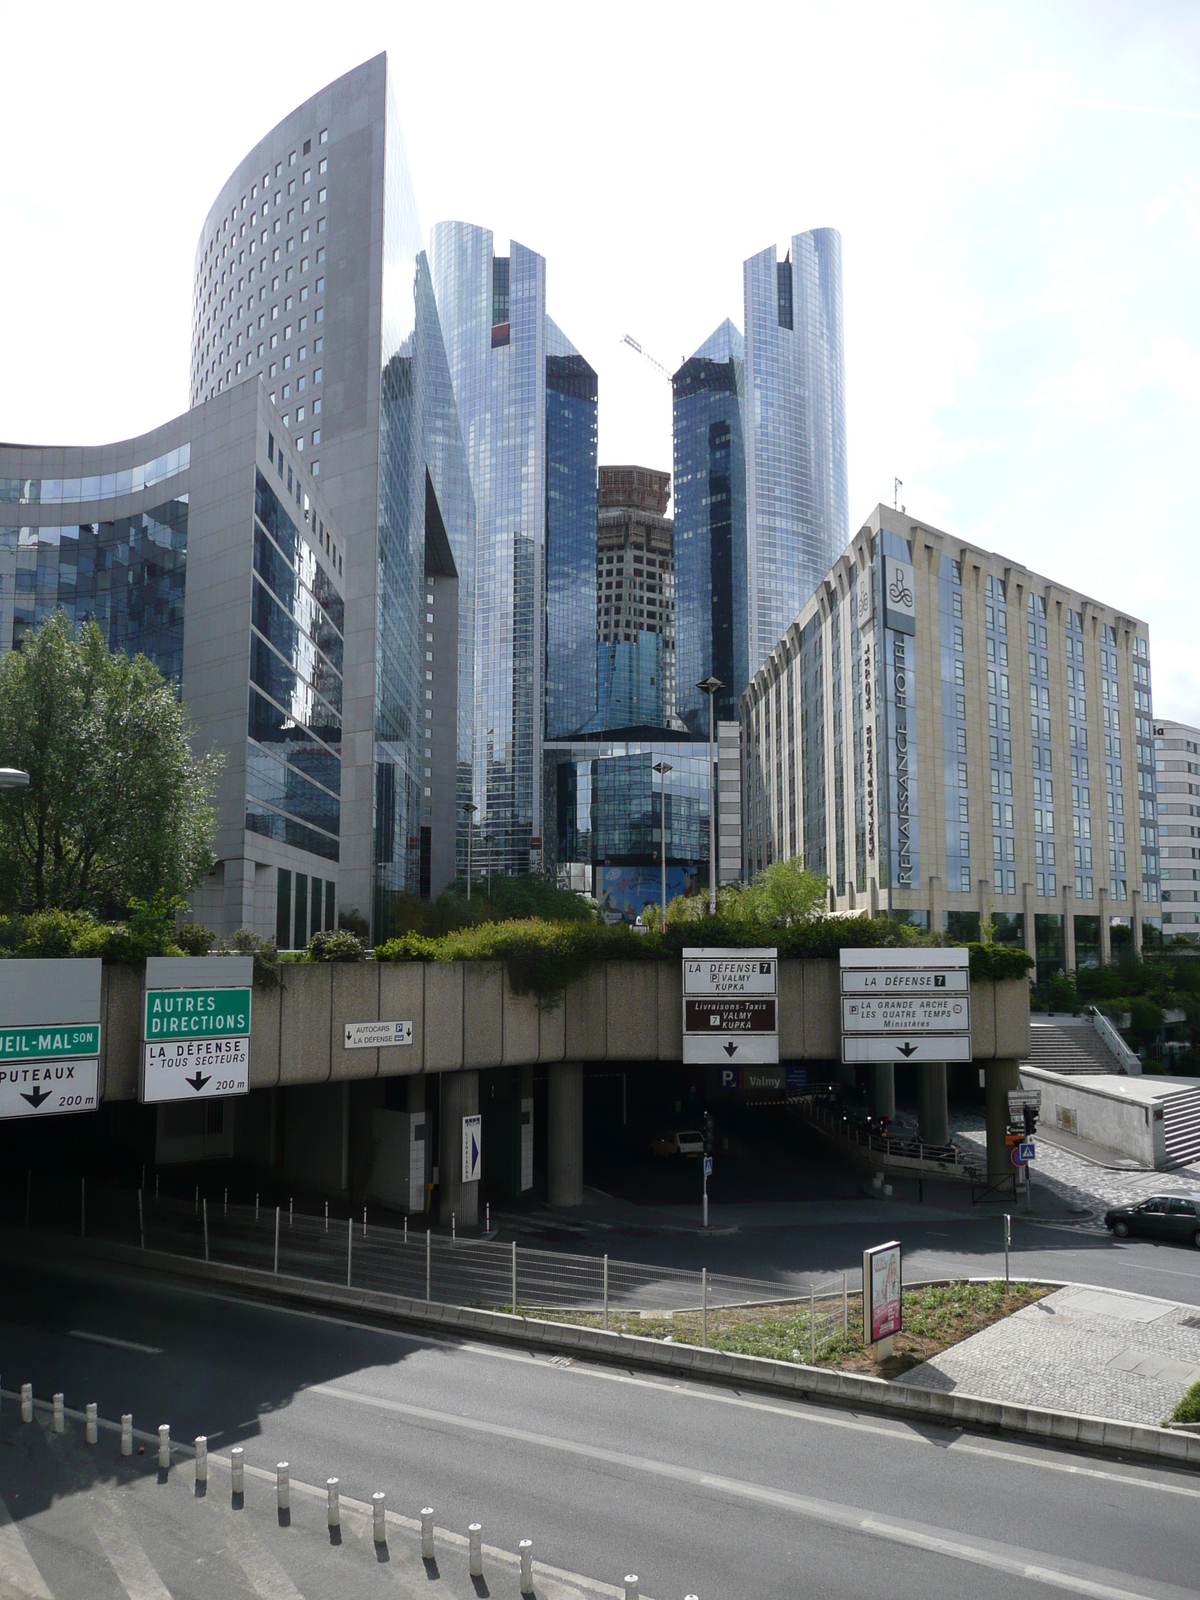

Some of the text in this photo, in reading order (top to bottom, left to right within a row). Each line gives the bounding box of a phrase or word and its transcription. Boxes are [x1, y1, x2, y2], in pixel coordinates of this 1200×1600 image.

[894, 637, 912, 885] RENAISSANCE HOTEL
[689, 961, 768, 973] LA DÉFENSE 7
[722, 974, 751, 982] VALMY
[864, 975, 943, 986] LA DÉFENSE 7
[715, 983, 745, 991] KUPKA
[153, 997, 216, 1013] AUTRES
[861, 1001, 871, 1009] LA
[877, 1001, 914, 1009] GRANDE
[919, 1001, 949, 1009] ARCHE
[722, 1012, 752, 1020] VALMY
[882, 1010, 917, 1018] QUATRE
[923, 1010, 952, 1018] TEMPS
[152, 1014, 245, 1033] DIRECTIONS
[356, 1025, 390, 1033] AUTOCARS
[722, 1021, 752, 1029] KUPKA
[883, 1020, 930, 1028] Ministères
[364, 1035, 393, 1044] DÉFENSE
[150, 1041, 241, 1058] LA DÉFENSE
[161, 1057, 188, 1068] TOUS
[195, 1053, 246, 1066] SECTEURS
[0, 1066, 75, 1084] PUTEAUX
[216, 1079, 235, 1091] 200
[749, 1076, 780, 1088] Valmy
[59, 1095, 94, 1107] 200 m
